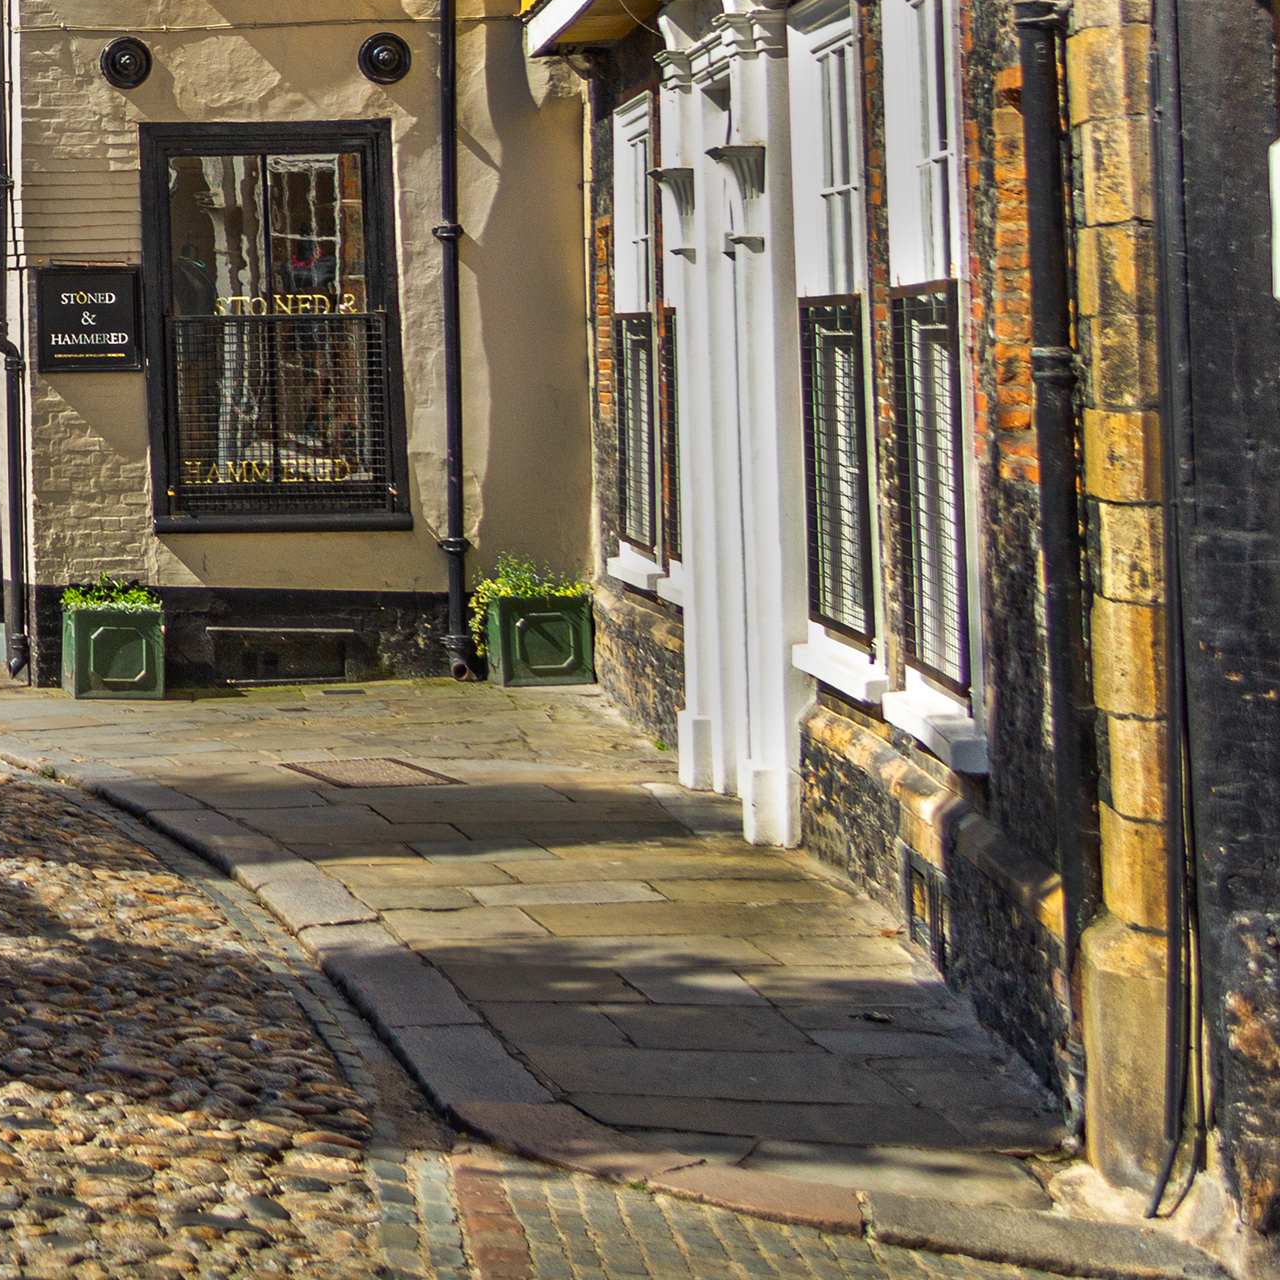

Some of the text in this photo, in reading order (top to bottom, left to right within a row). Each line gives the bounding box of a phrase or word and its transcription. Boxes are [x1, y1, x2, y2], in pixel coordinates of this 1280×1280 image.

[60, 292, 116, 305] STONED
[80, 310, 97, 326] &
[50, 333, 129, 345] HAMMERED
[185, 460, 351, 483] HAMMERED
